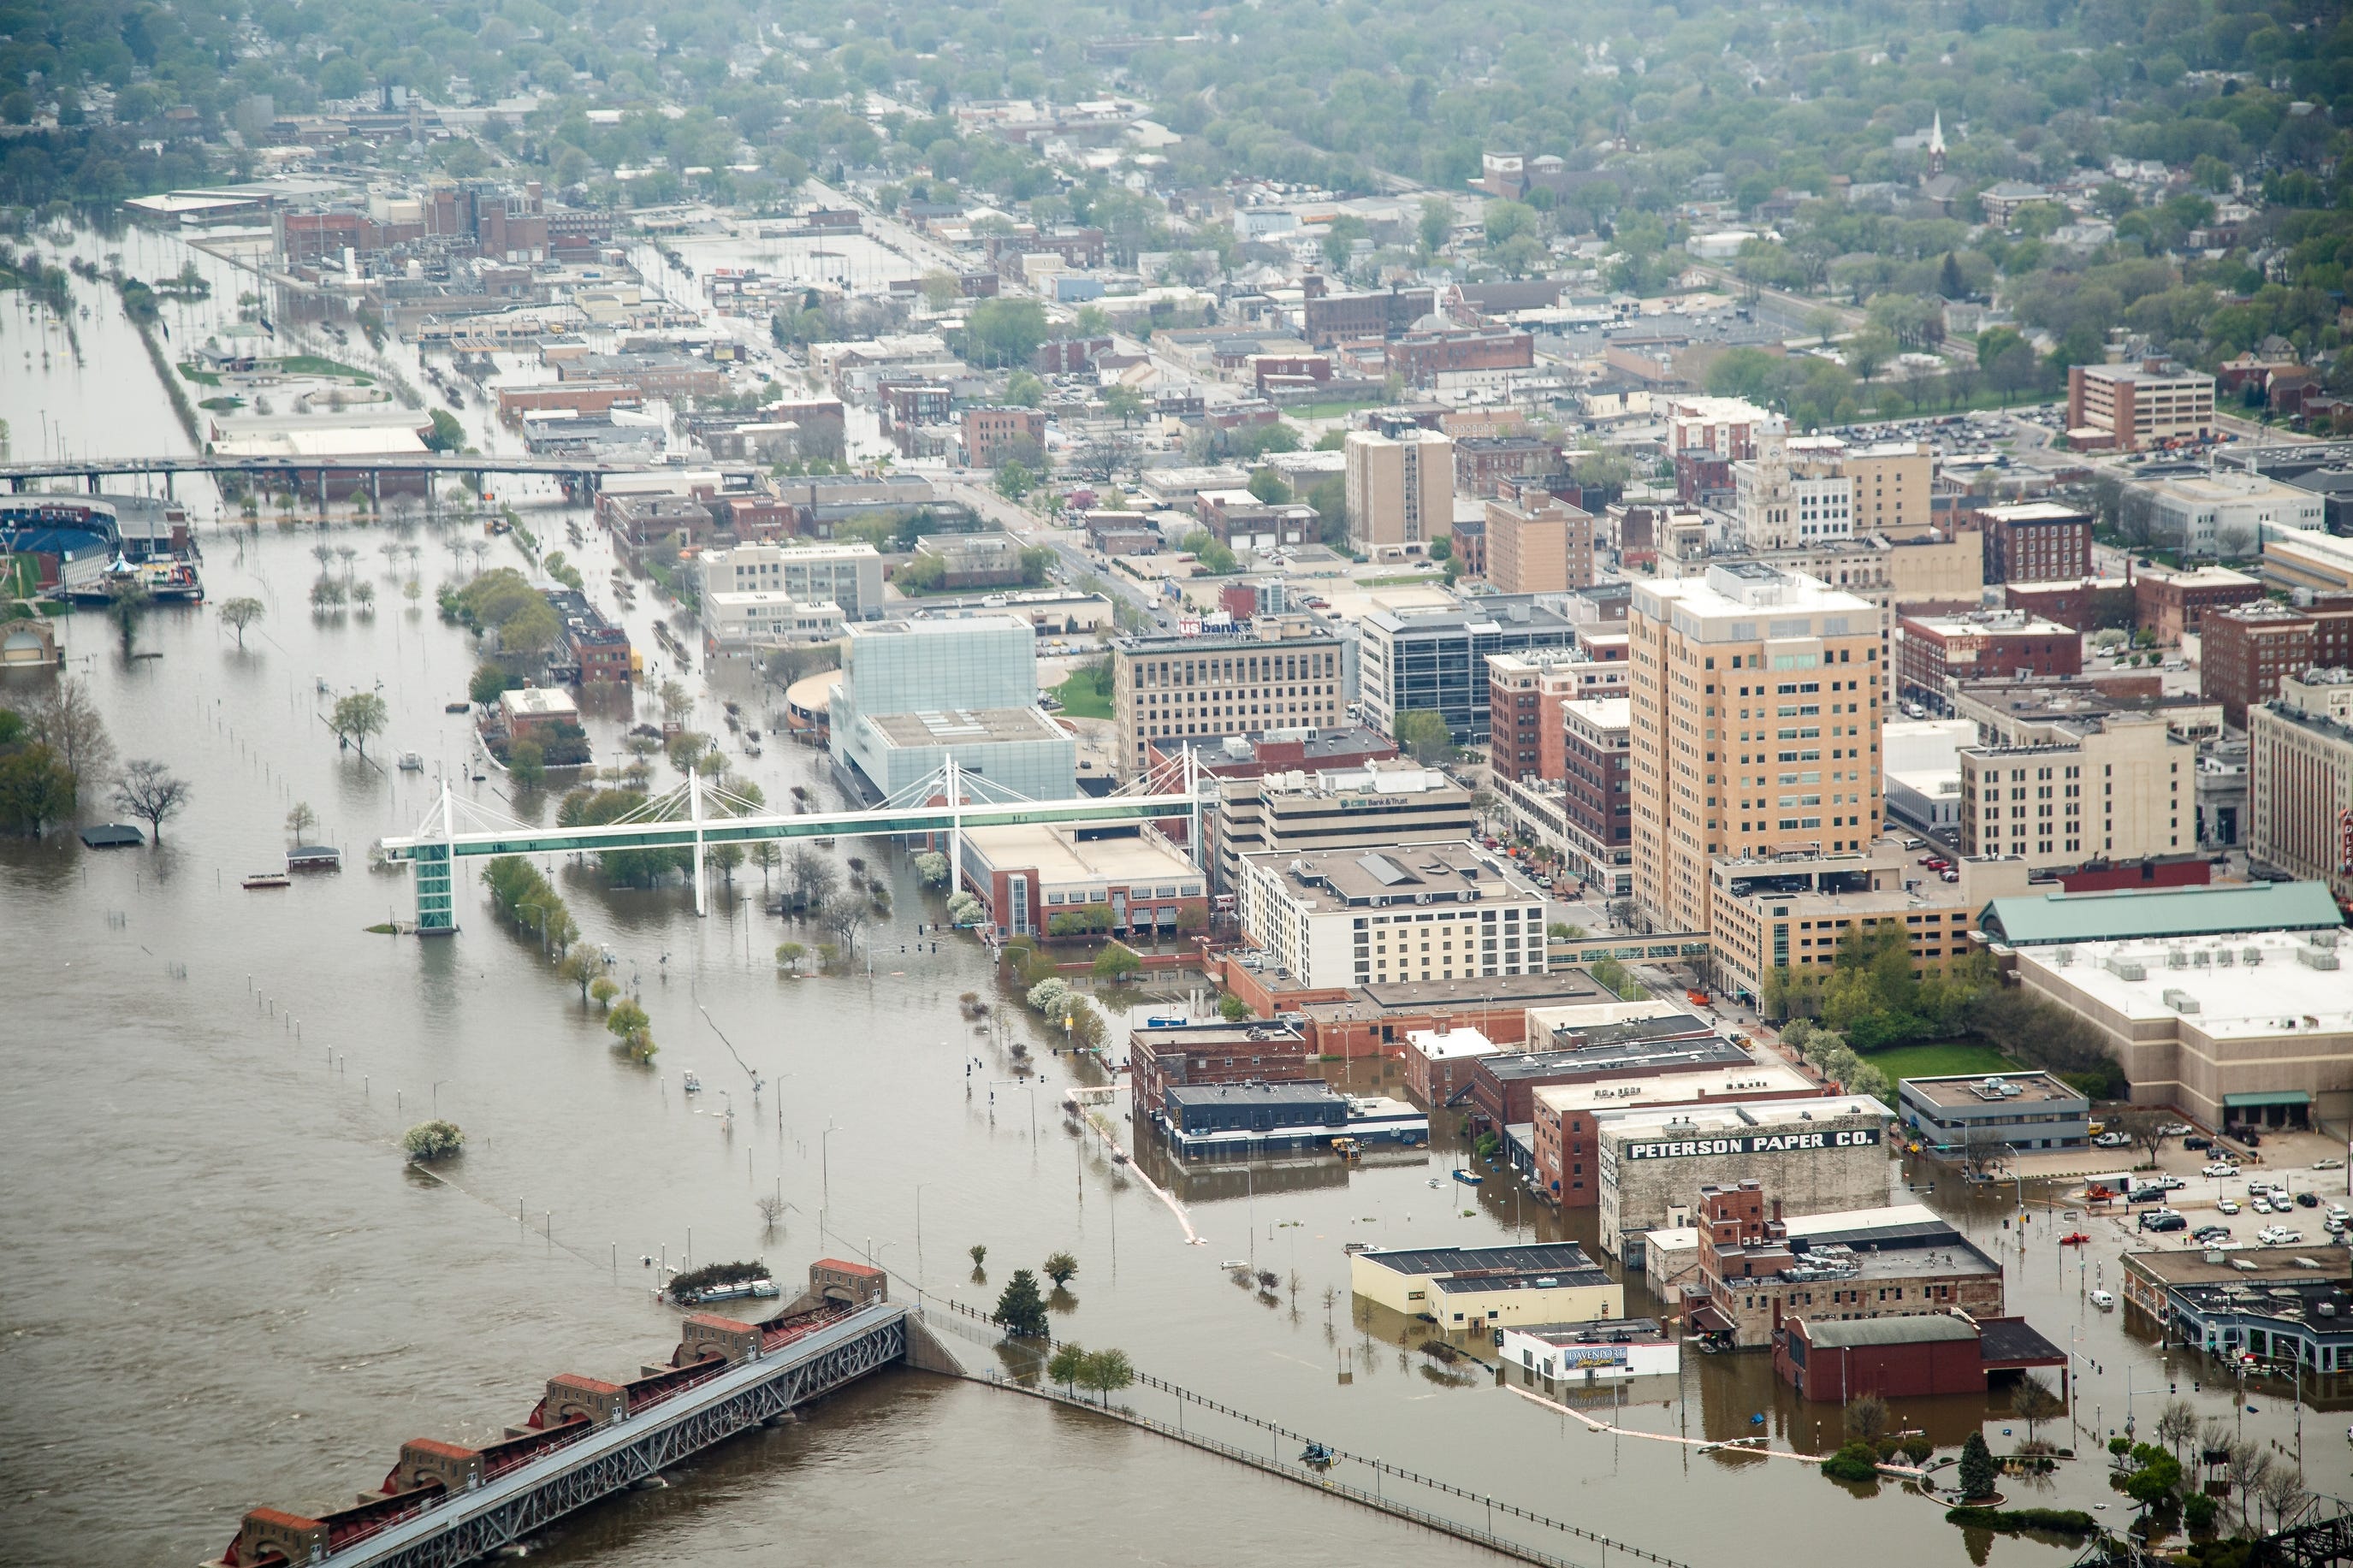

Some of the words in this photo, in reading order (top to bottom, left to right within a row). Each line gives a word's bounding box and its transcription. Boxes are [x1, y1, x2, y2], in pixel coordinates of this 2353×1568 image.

[1632, 1139, 1743, 1158] PETERSON
[1754, 1133, 1824, 1152] PAPER
[1836, 1130, 1873, 1146] CO.
[1569, 1349, 1624, 1360] DAVENPORT
